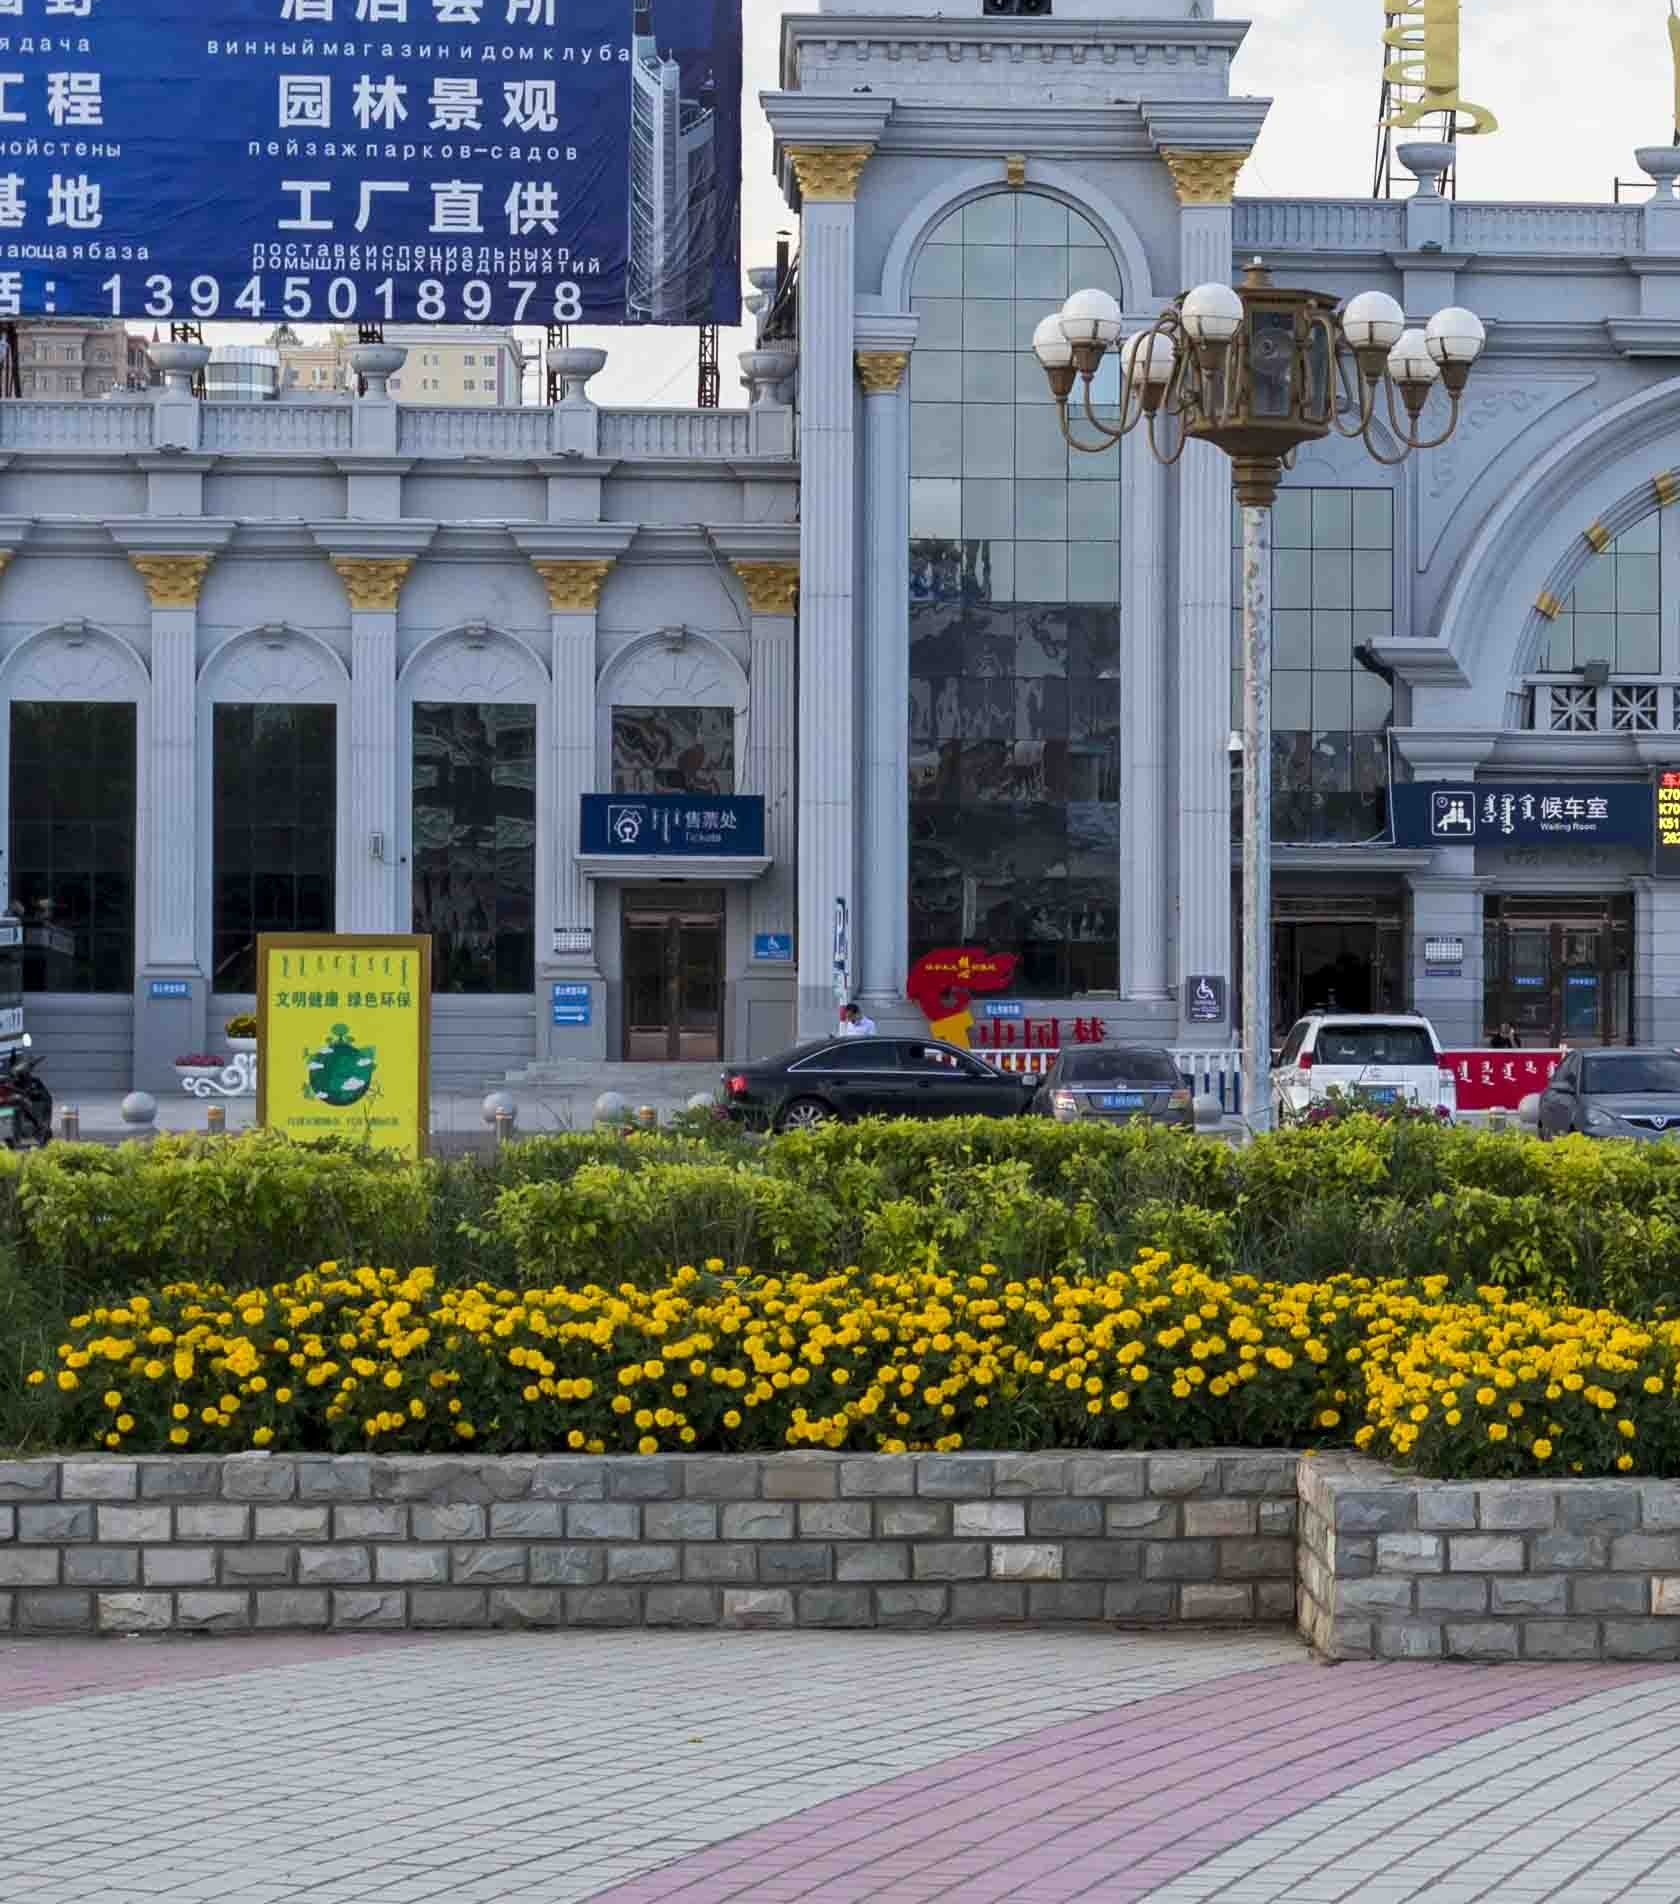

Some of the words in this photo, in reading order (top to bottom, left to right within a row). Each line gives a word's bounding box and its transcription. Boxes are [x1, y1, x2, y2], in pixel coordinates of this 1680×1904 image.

[278, 73, 559, 132] 园林景观
[277, 178, 560, 237] 工厂直供
[685, 810, 737, 830] 售票处
[1540, 796, 1609, 820] 候车室
[1540, 822, 1571, 833] Waiting
[1572, 823, 1597, 831] Room
